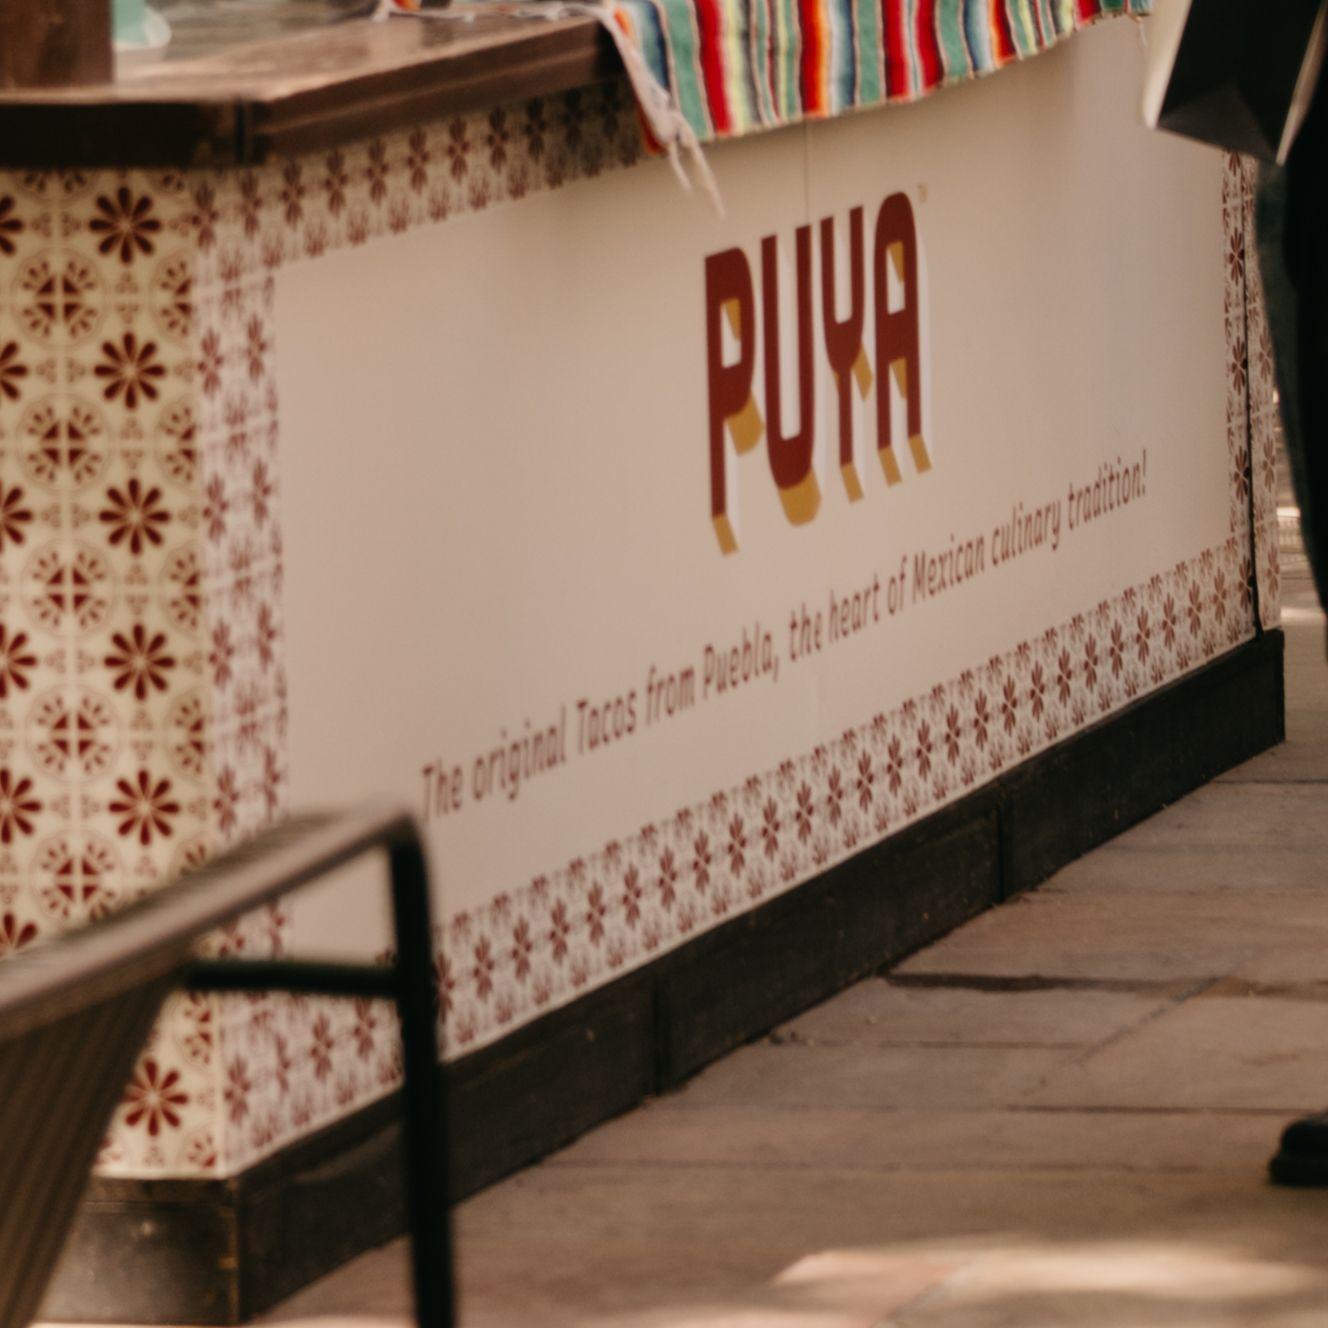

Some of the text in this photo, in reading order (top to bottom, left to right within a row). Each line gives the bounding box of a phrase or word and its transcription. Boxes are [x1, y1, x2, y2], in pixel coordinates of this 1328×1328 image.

[703, 190, 932, 556] PUYA
[421, 449, 1149, 820] The original Tacos from Puebla, the heart of Mexican culinary tradition!
